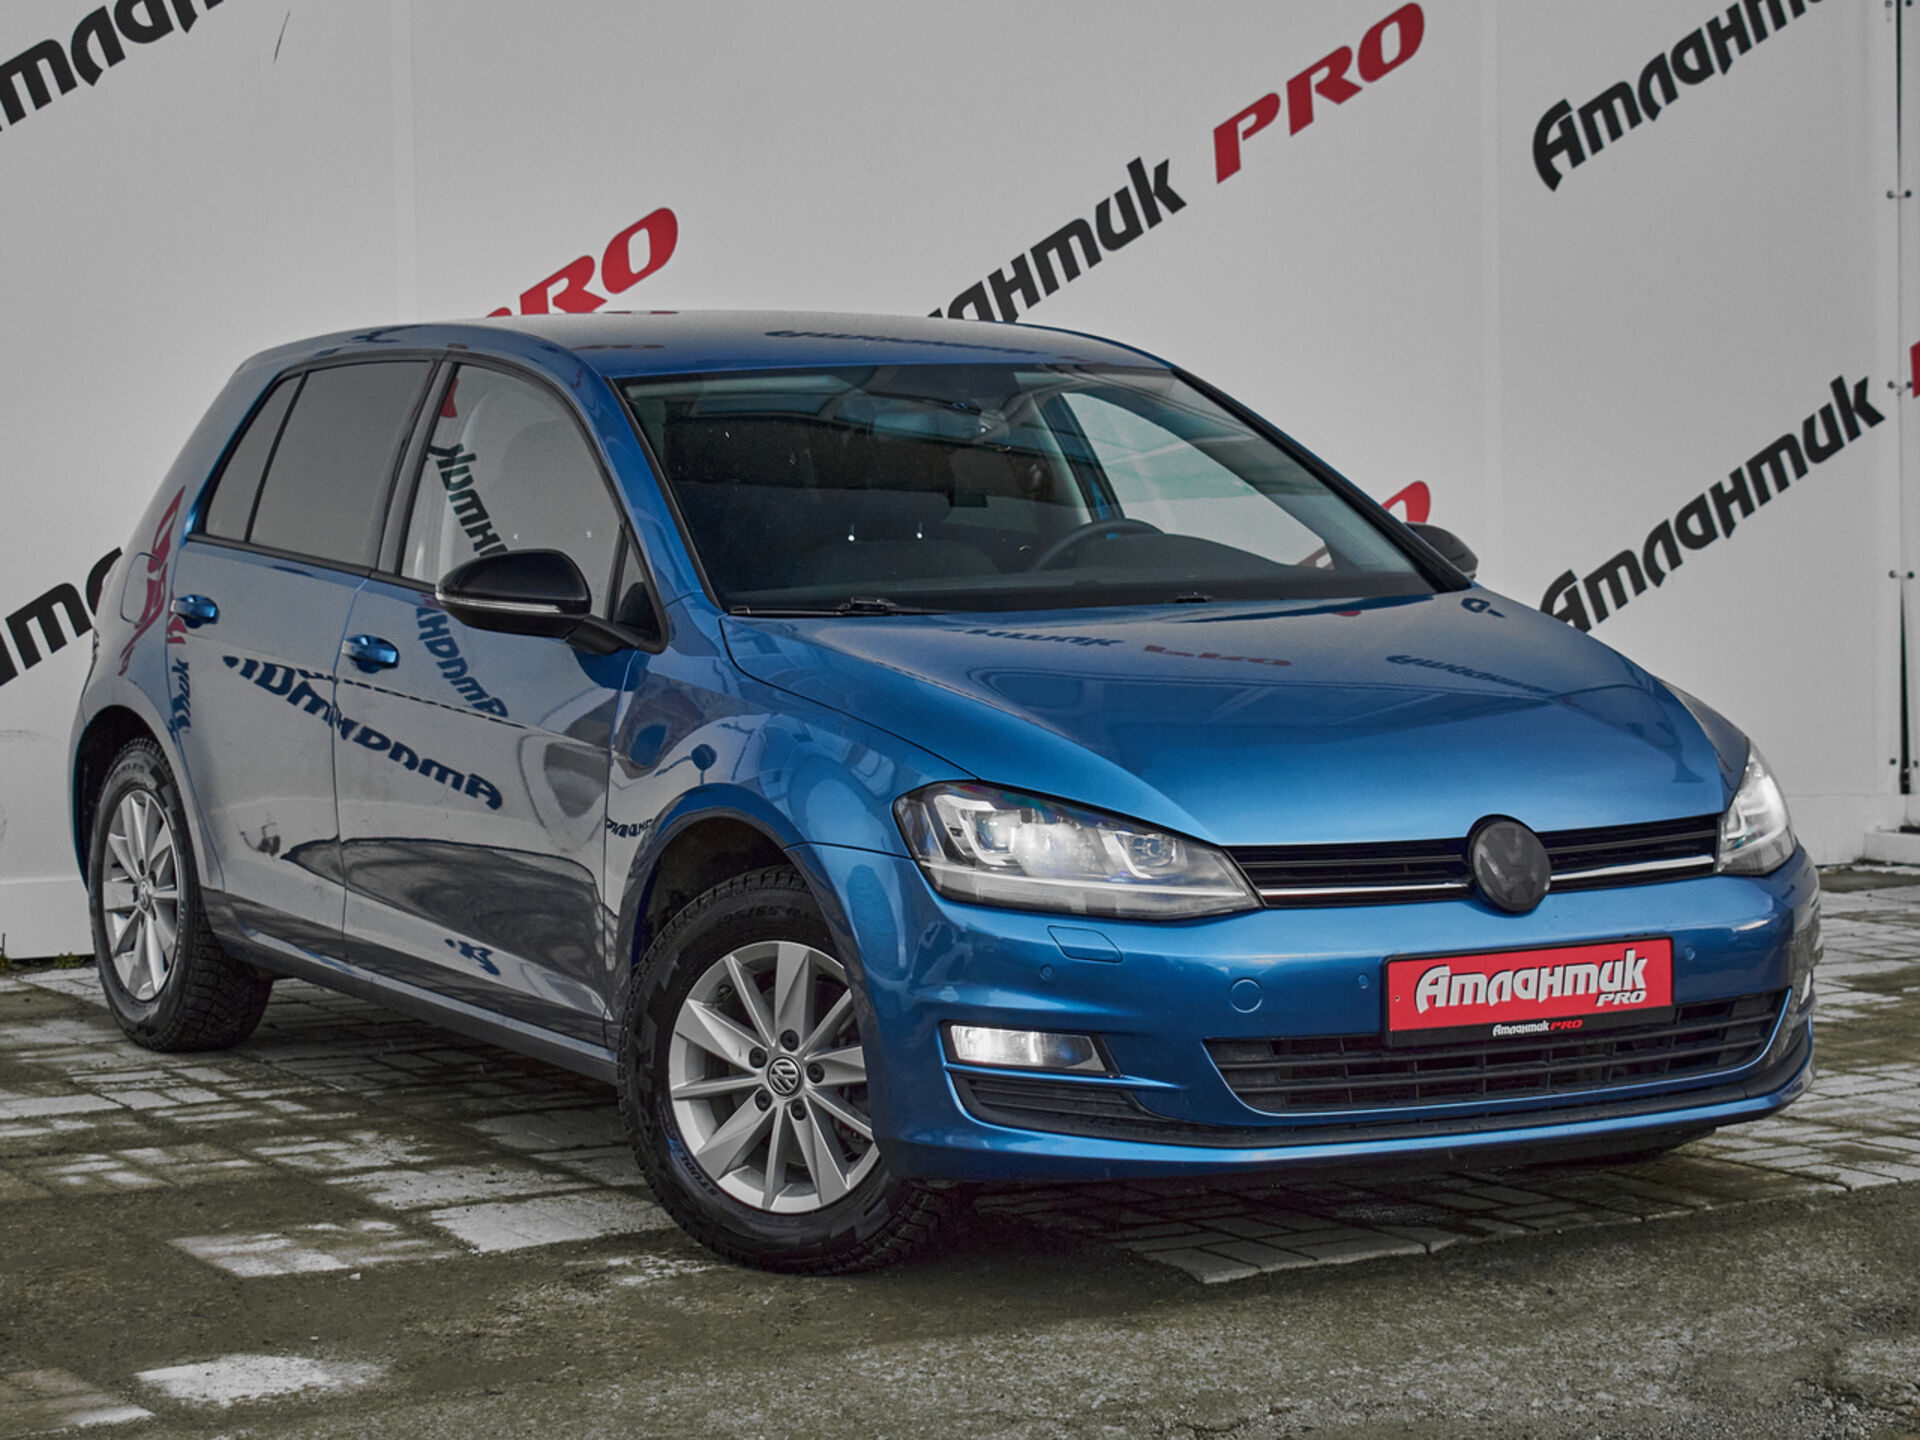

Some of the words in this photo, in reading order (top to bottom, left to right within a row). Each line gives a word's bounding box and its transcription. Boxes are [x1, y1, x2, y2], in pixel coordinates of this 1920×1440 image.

[1532, 0, 1823, 192] Атлант
[928, 156, 1187, 323] антик
[1213, 3, 1425, 183] PRO
[487, 207, 679, 318] RO
[1540, 375, 1886, 634] Атлантик
[1415, 949, 1649, 1014] Атлантик
[1492, 1020, 1550, 1037] Атлантик
[1549, 1019, 1583, 1031] PRO
[1596, 989, 1648, 1007] PRO
